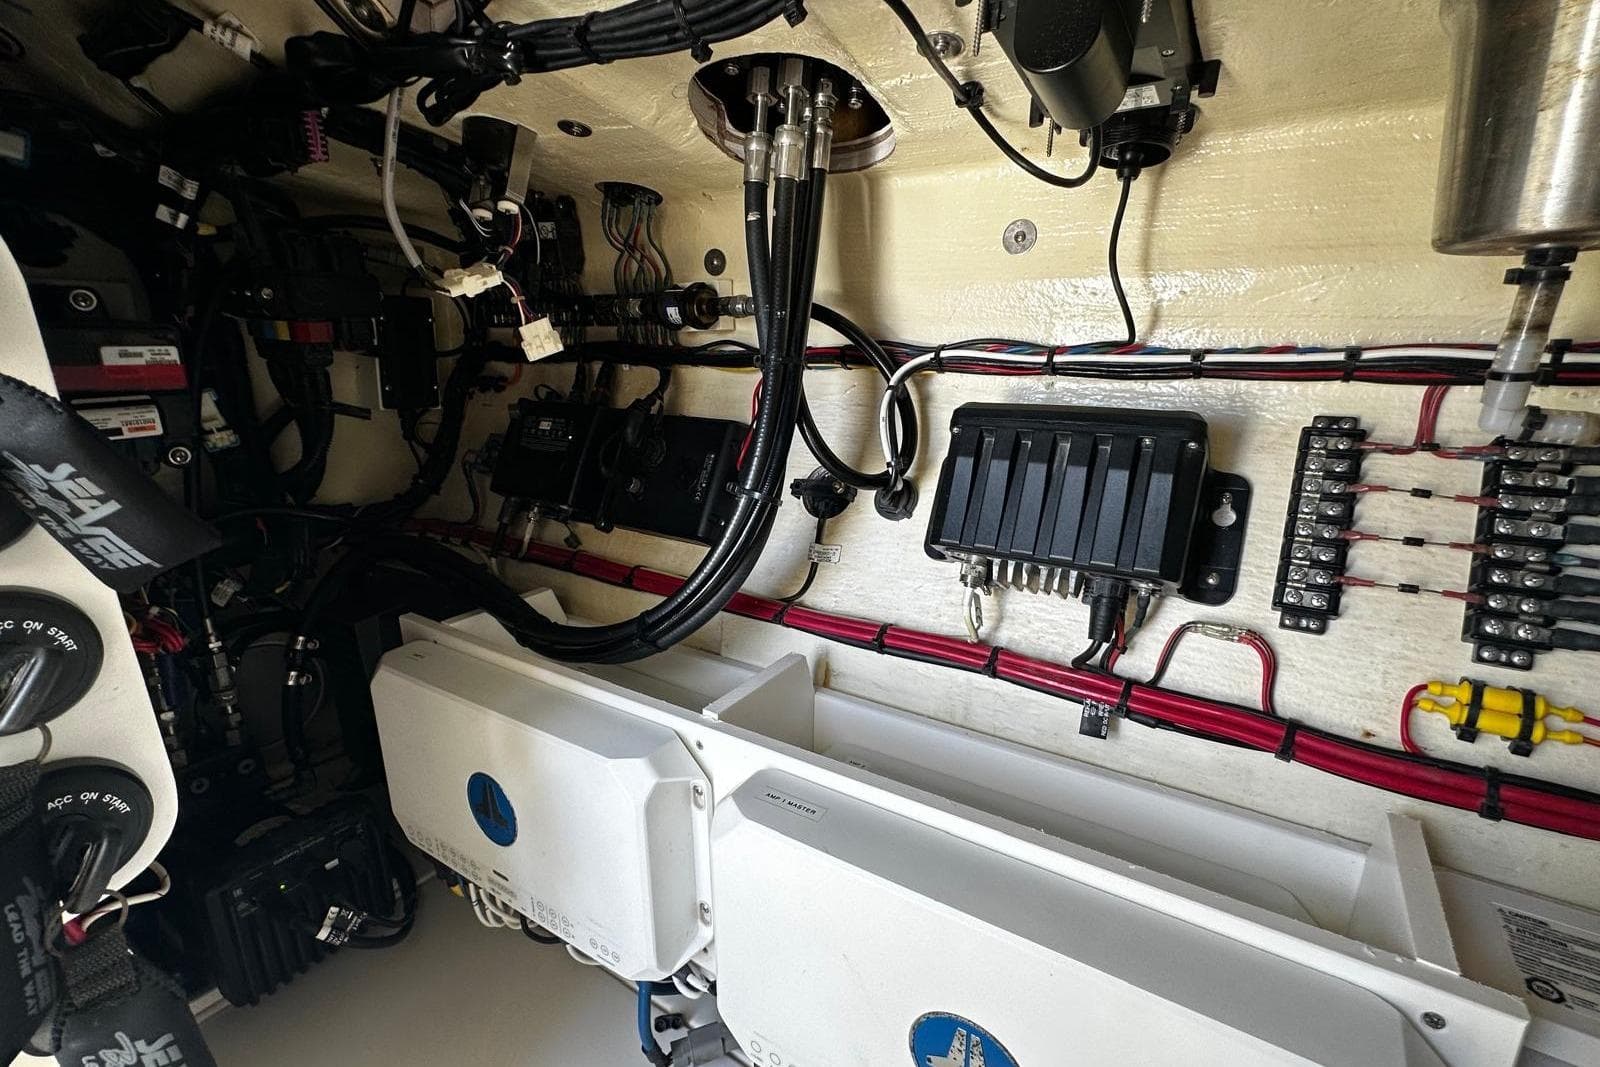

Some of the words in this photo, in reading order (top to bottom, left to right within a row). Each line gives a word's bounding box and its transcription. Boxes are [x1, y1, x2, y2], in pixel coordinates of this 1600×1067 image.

[37, 512, 76, 539] THE
[71, 542, 118, 571] WAY
[22, 620, 44, 631] ON
[47, 626, 79, 651] START
[47, 795, 73, 811] ACC
[80, 791, 99, 801] ON
[102, 793, 131, 814] START
[765, 792, 782, 801] AMP
[787, 800, 817, 816] MASTER
[5, 904, 25, 944] LEAD
[16, 947, 32, 979] THE
